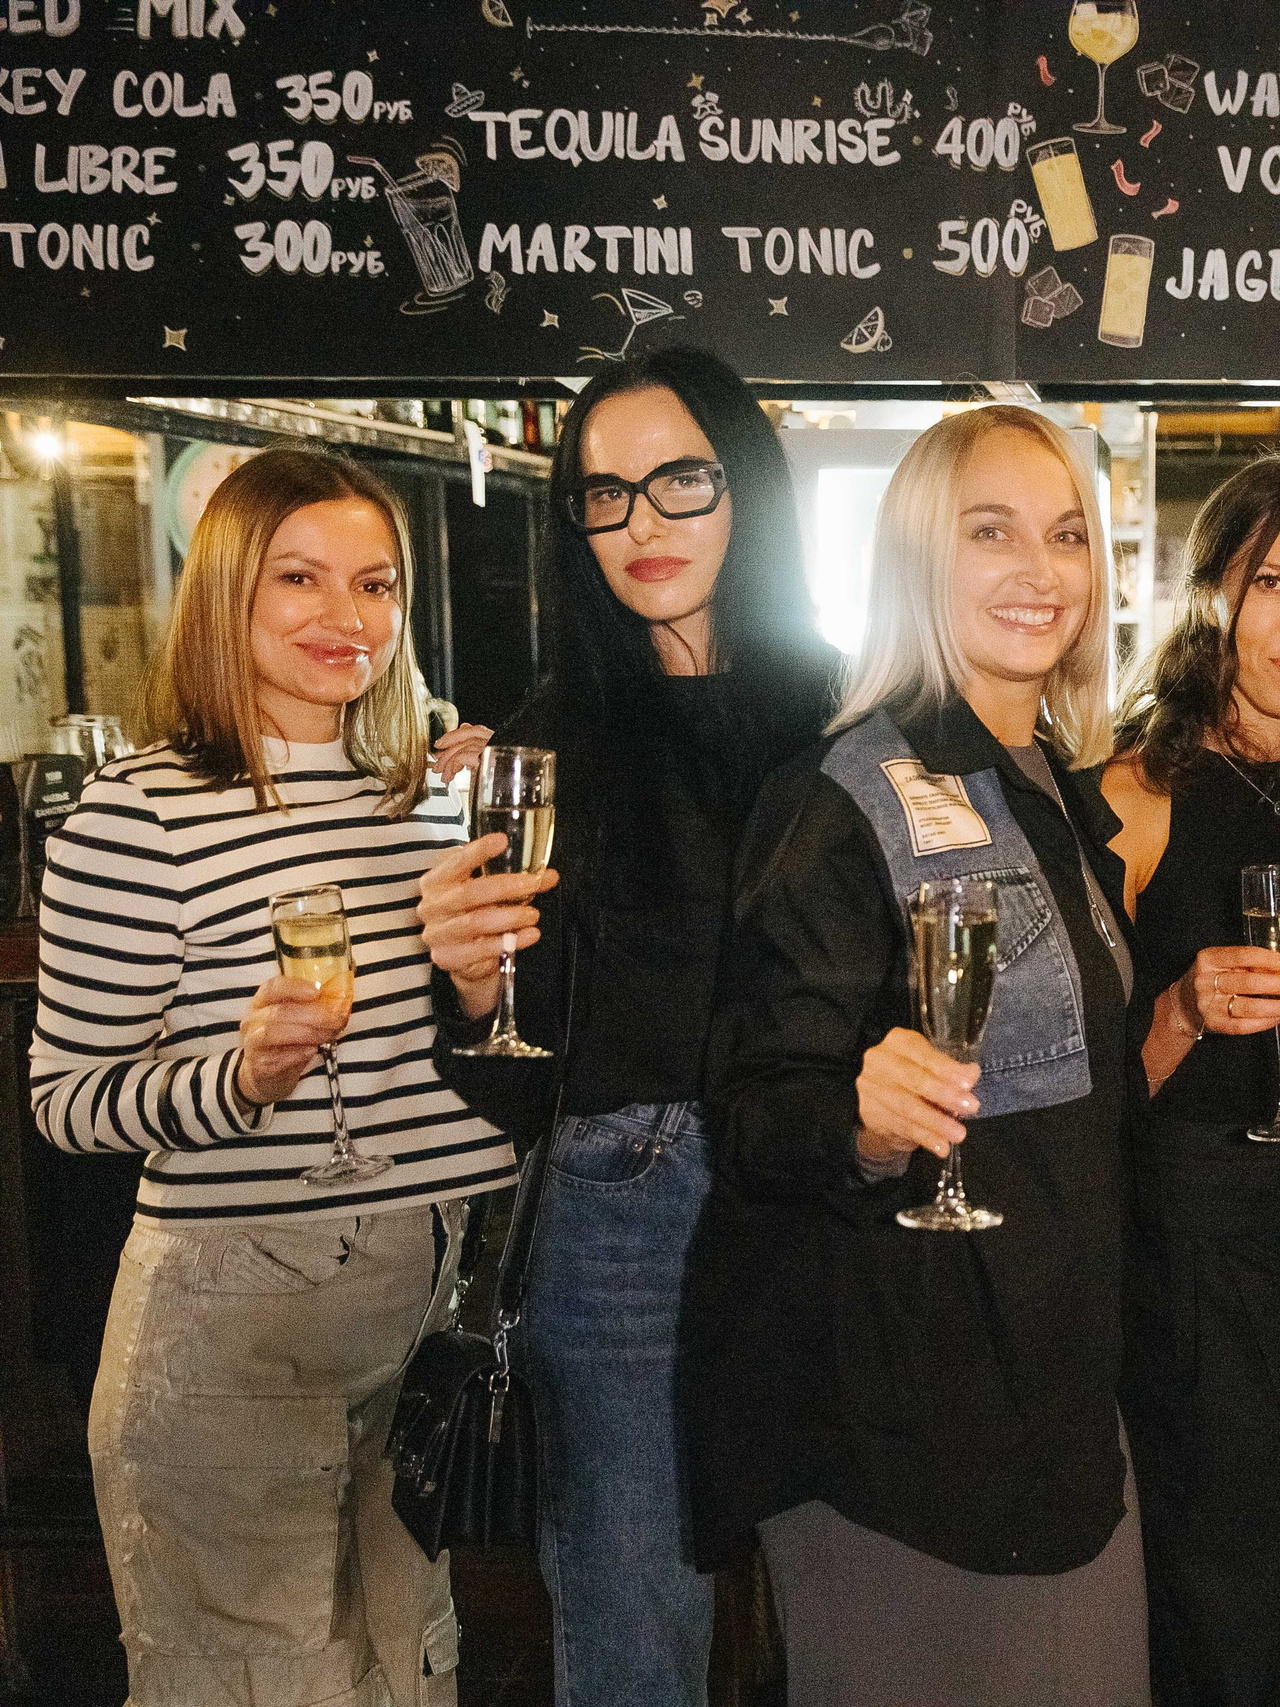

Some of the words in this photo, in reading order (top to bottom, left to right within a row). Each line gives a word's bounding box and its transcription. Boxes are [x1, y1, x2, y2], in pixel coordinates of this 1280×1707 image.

[0, 0, 81, 37] ED
[137, 0, 246, 39] MIX
[113, 70, 237, 118] COLA
[276, 70, 374, 122] 350
[467, 109, 686, 168] TEQUILA
[699, 116, 901, 167] SUNRISE
[933, 115, 1020, 170] 400
[34, 143, 178, 196] LIBRE
[226, 140, 334, 199] 350
[0, 222, 155, 272] TONIC
[236, 219, 333, 275] 300
[478, 223, 694, 276] MARTINI
[722, 226, 882, 279] TONIC
[934, 217, 1030, 277] 500
